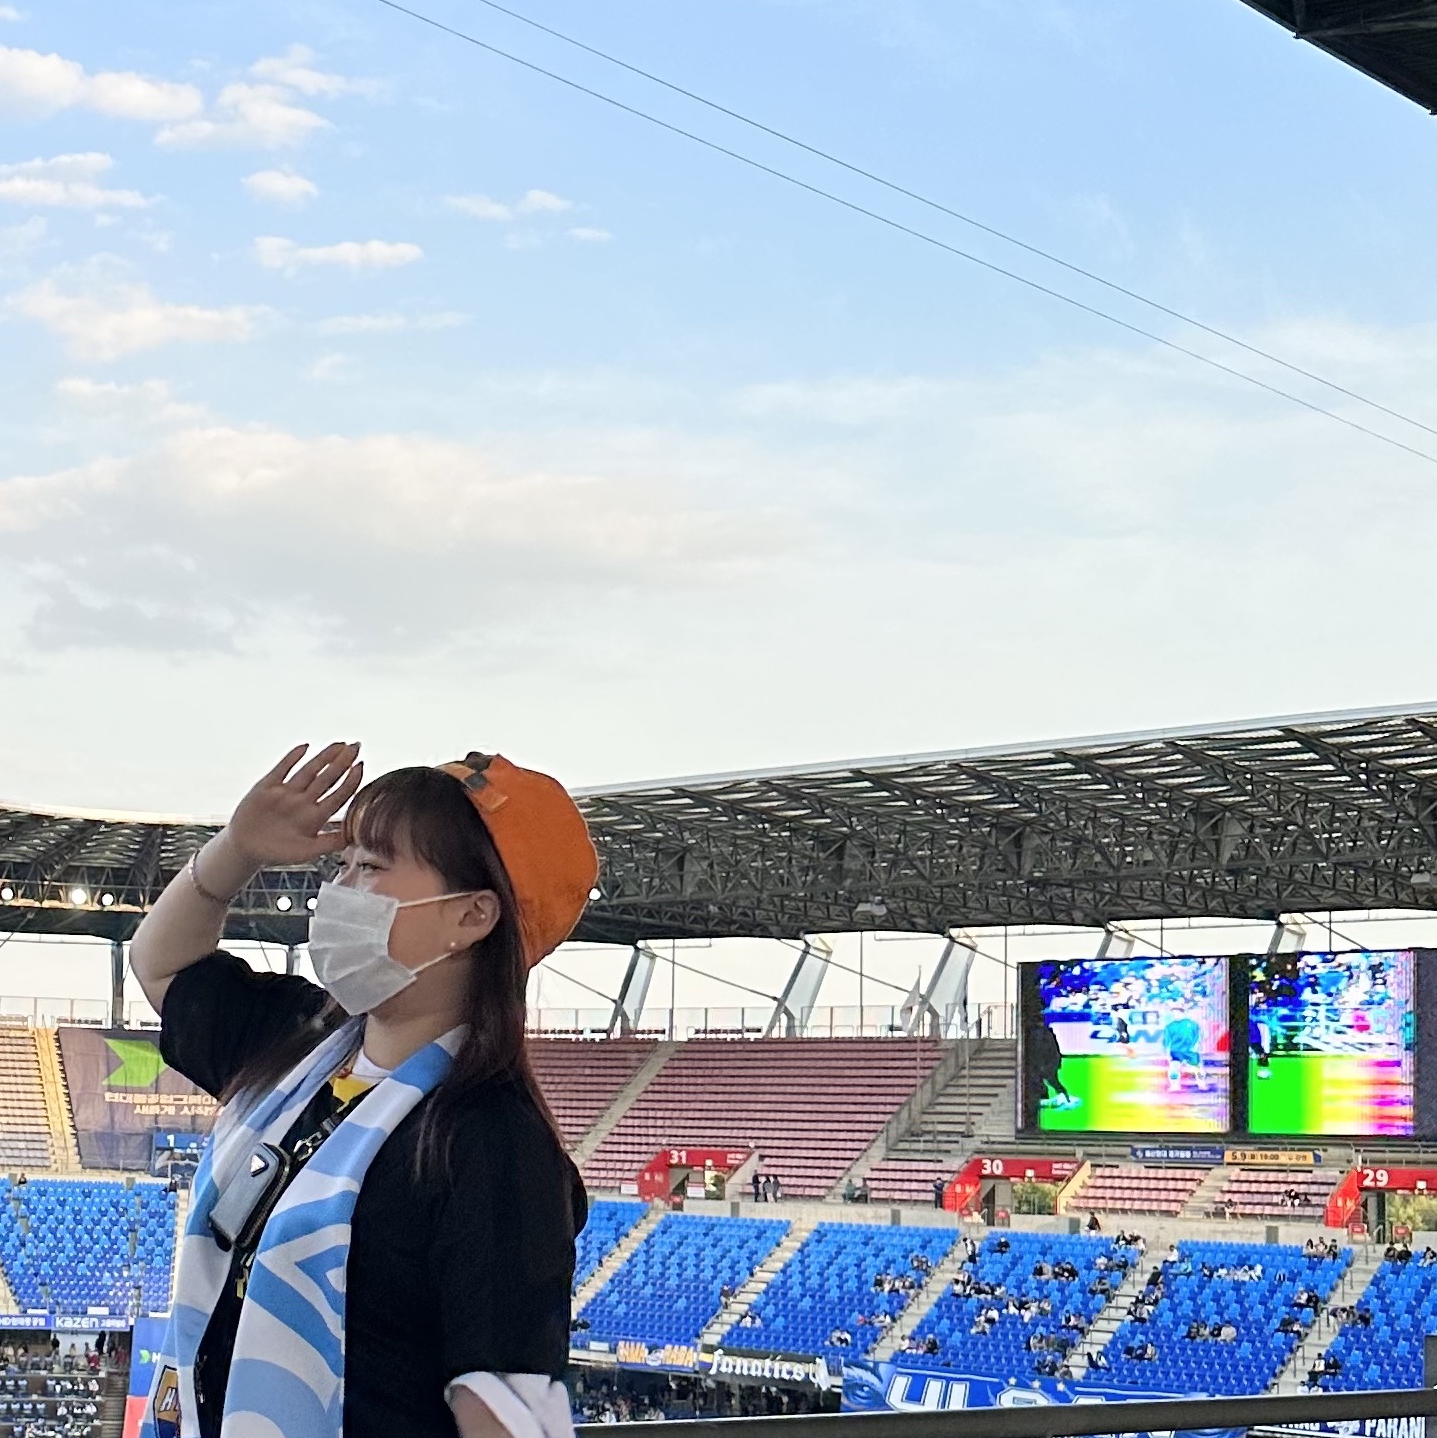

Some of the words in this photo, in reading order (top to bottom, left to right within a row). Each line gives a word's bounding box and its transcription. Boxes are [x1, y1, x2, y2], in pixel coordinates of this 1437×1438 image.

[167, 1134, 175, 1148] 1
[669, 1150, 687, 1165] 31
[981, 1158, 1004, 1175] 30
[1362, 1169, 1389, 1187] 29
